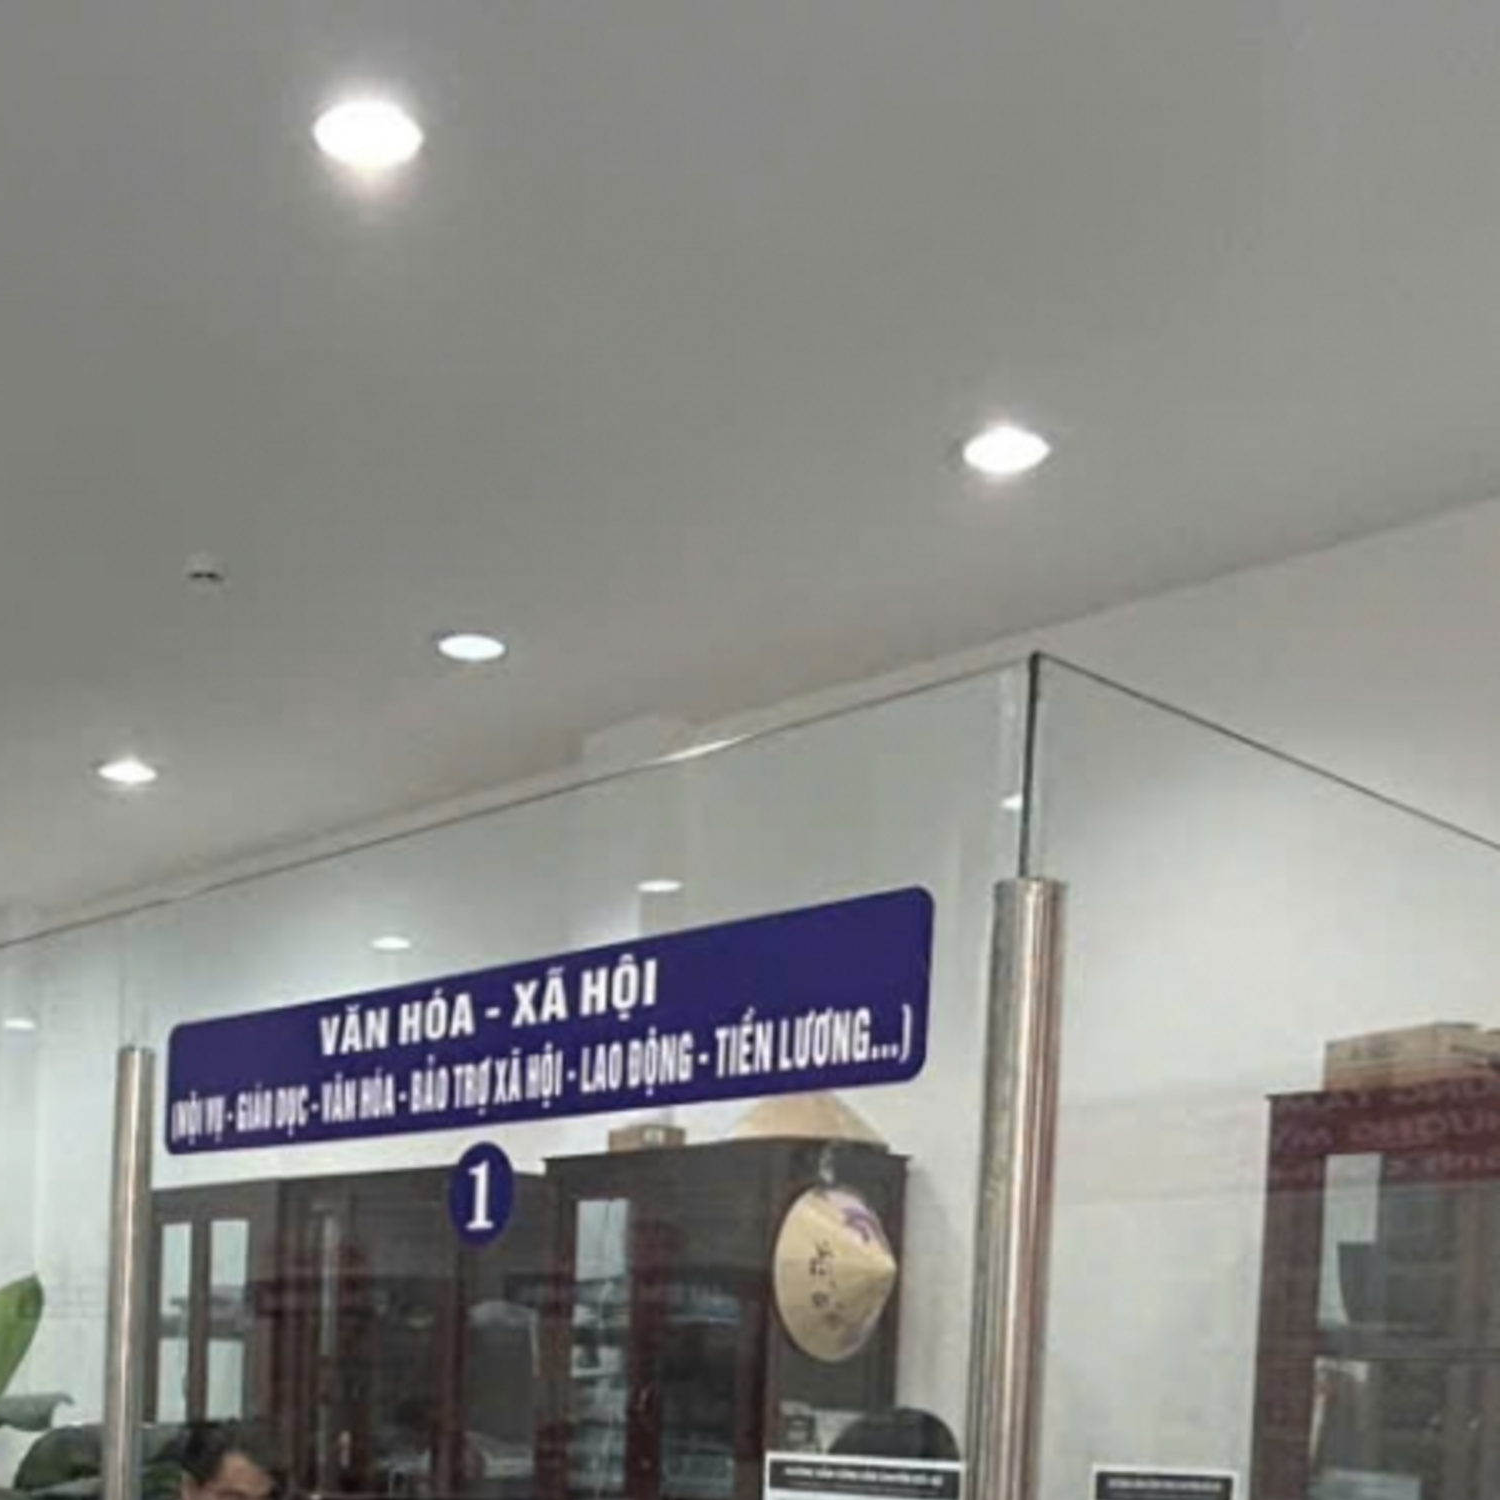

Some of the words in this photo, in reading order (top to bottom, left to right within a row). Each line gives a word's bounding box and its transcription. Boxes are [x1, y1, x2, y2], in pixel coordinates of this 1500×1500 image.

[320, 1004, 390, 1056] VĂN
[399, 988, 475, 1045] HÓA
[512, 966, 568, 1027] XÃ
[580, 953, 658, 1022] HỘI
[411, 1053, 450, 1113] BẢO
[494, 1047, 523, 1105] XÃ
[525, 1041, 563, 1109] HỘI
[581, 1042, 623, 1093] LAO
[627, 1025, 694, 1097] ĐỘNG
[467, 1160, 495, 1231] 1
